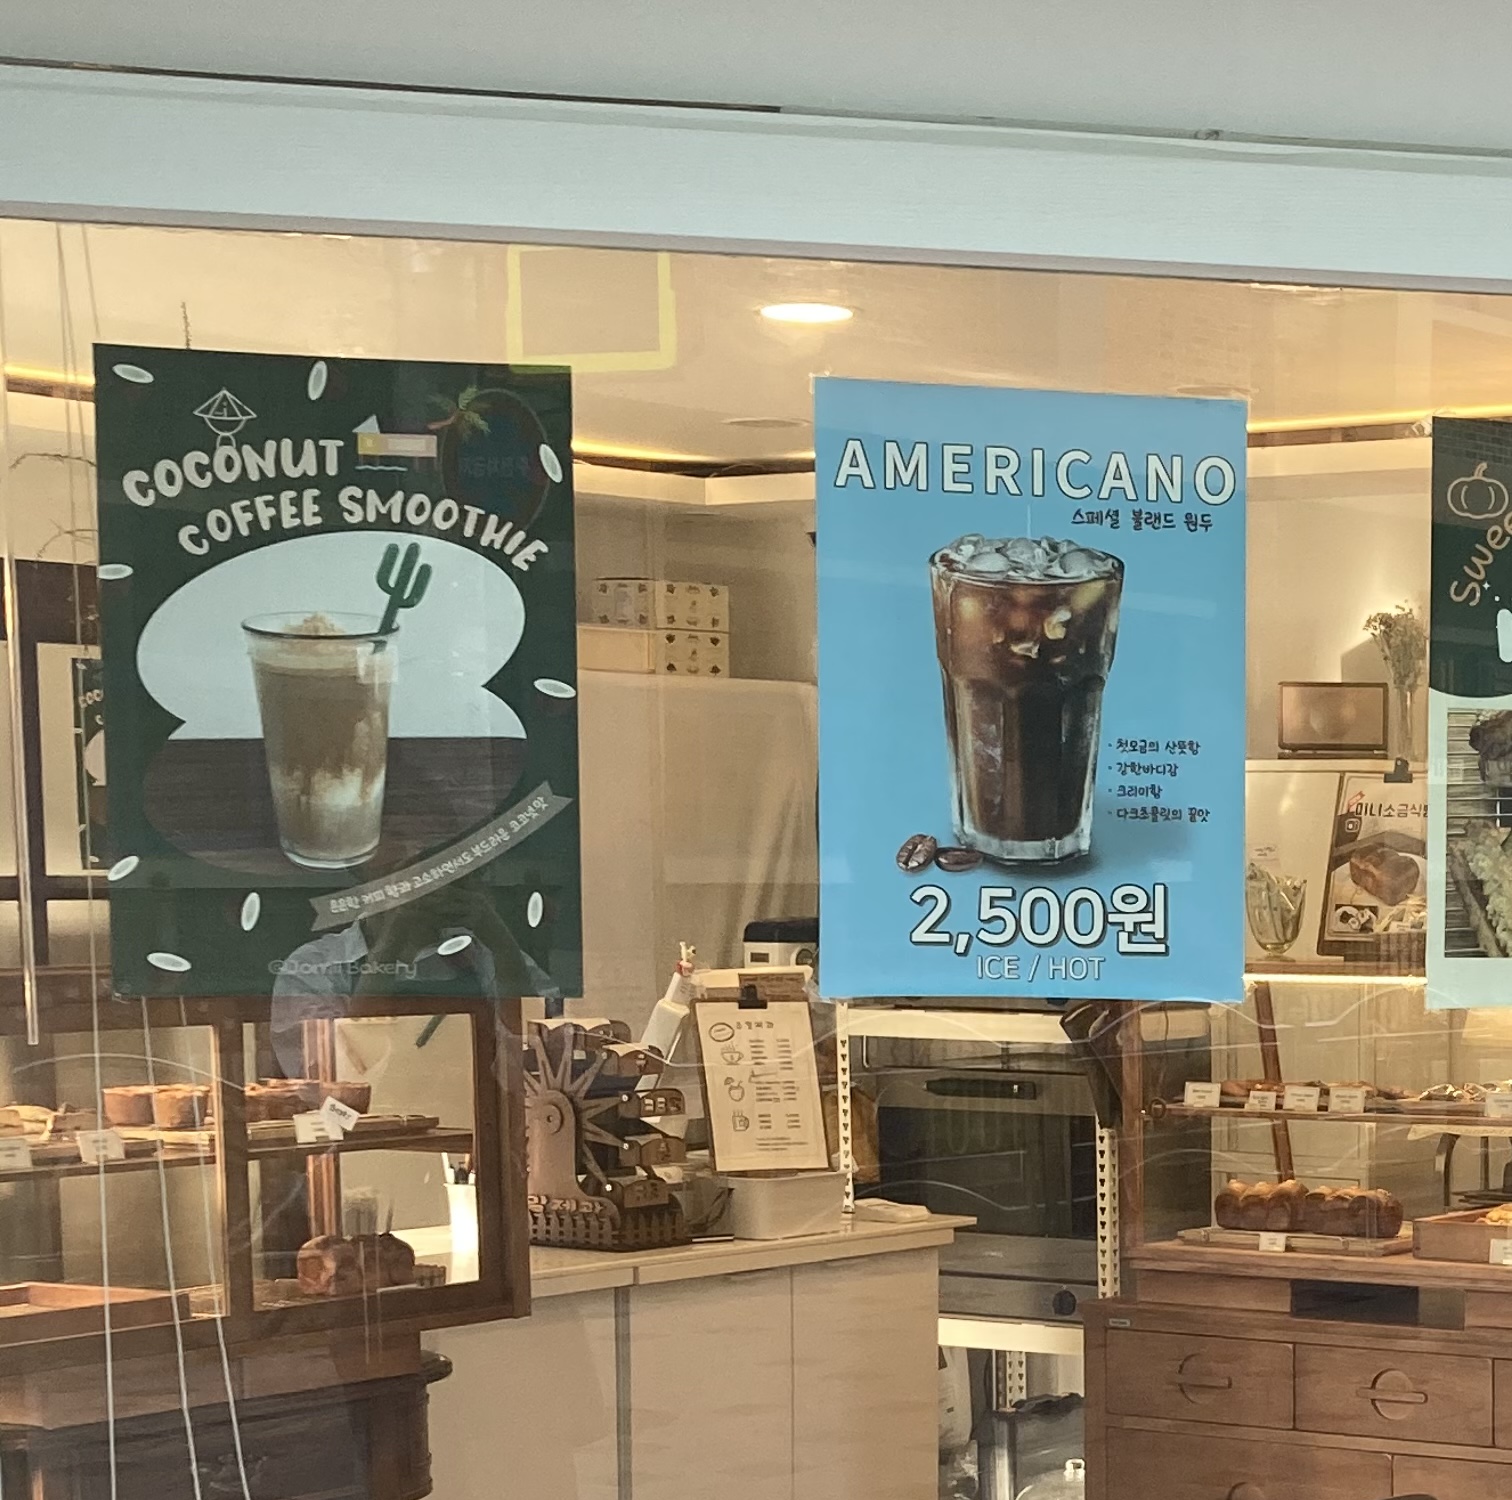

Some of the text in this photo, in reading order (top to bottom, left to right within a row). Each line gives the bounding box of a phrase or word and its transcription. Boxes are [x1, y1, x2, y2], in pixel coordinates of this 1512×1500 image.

[122, 438, 344, 507] COCONUT
[834, 438, 1236, 506] AMERICANO
[178, 486, 549, 572] COFFEE SMOOTHIE
[1071, 508, 1120, 529] 스페셜
[1184, 512, 1213, 532] 원두
[909, 883, 1169, 957] 2,500원
[977, 953, 1105, 982] ICE / HOT
